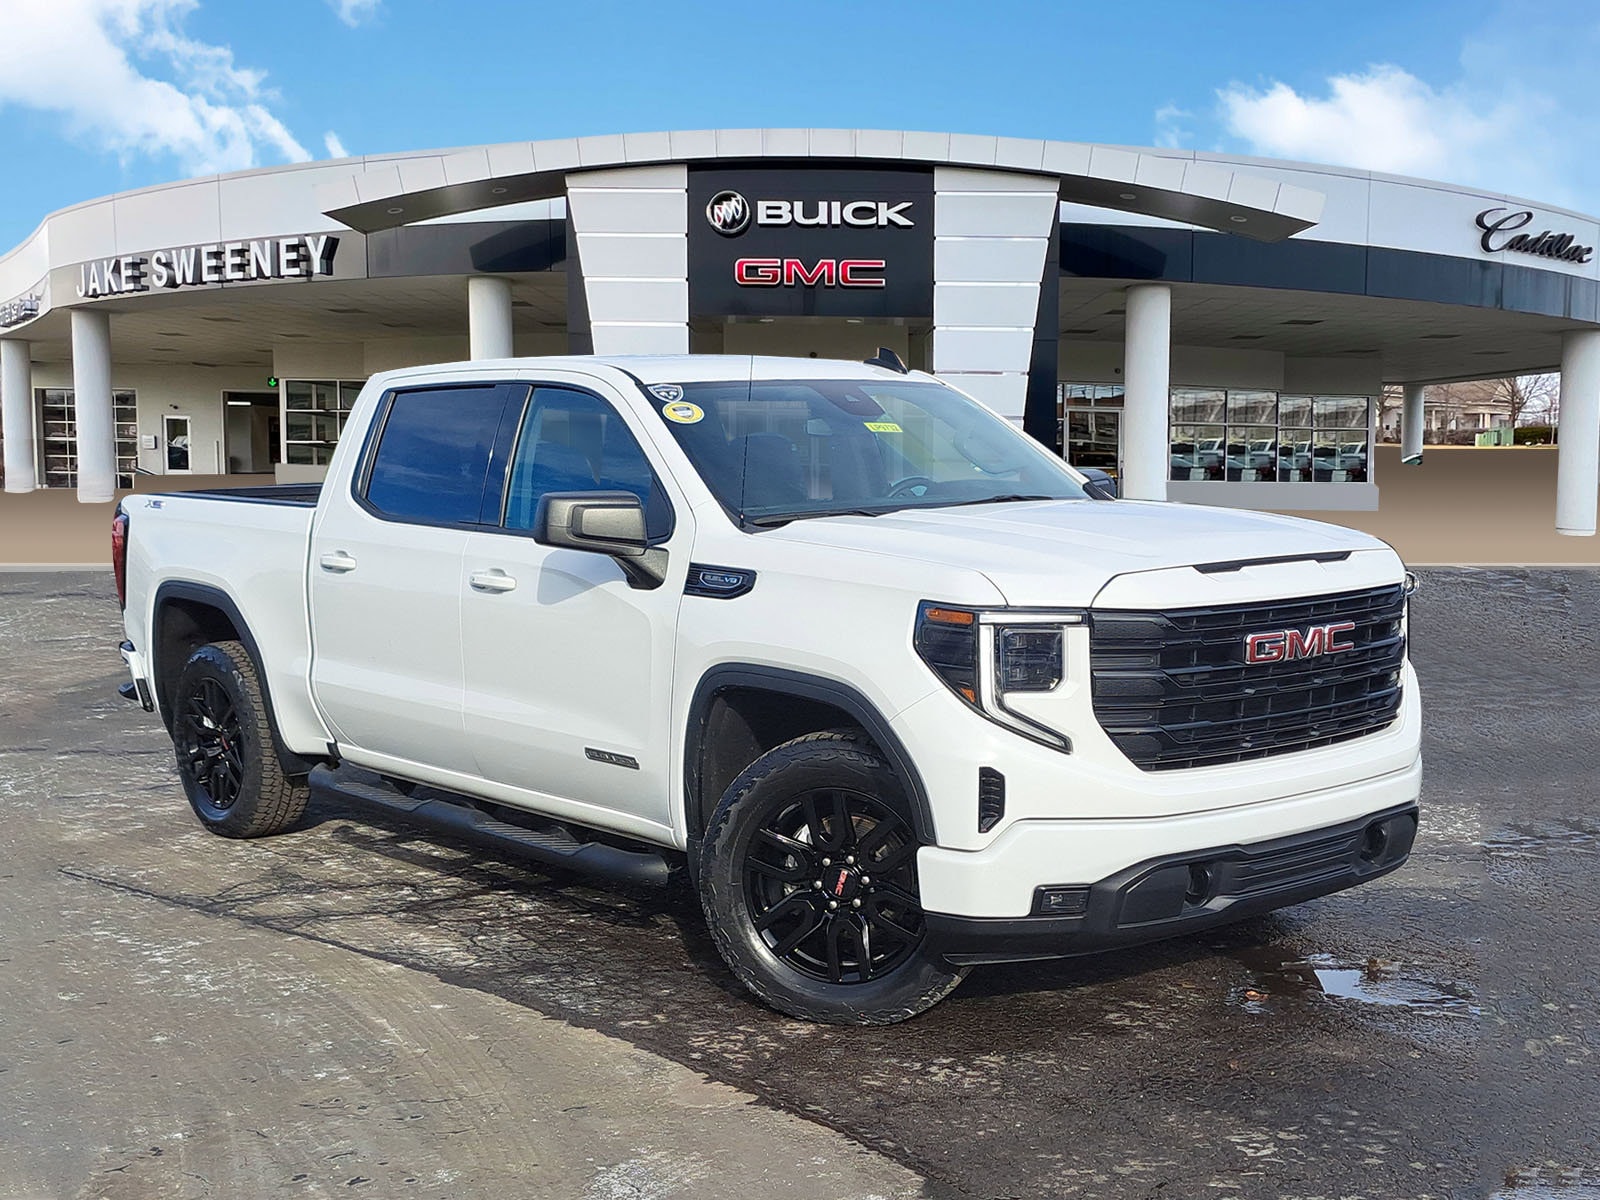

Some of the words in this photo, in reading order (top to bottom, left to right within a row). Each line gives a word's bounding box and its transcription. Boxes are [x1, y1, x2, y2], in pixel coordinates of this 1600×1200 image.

[757, 200, 914, 226] BUICK
[1475, 207, 1593, 264] Cadillac
[76, 255, 143, 298] JAKE
[151, 234, 334, 289] SWEENEY
[735, 258, 885, 287] GMC
[1245, 621, 1356, 664] GMC
